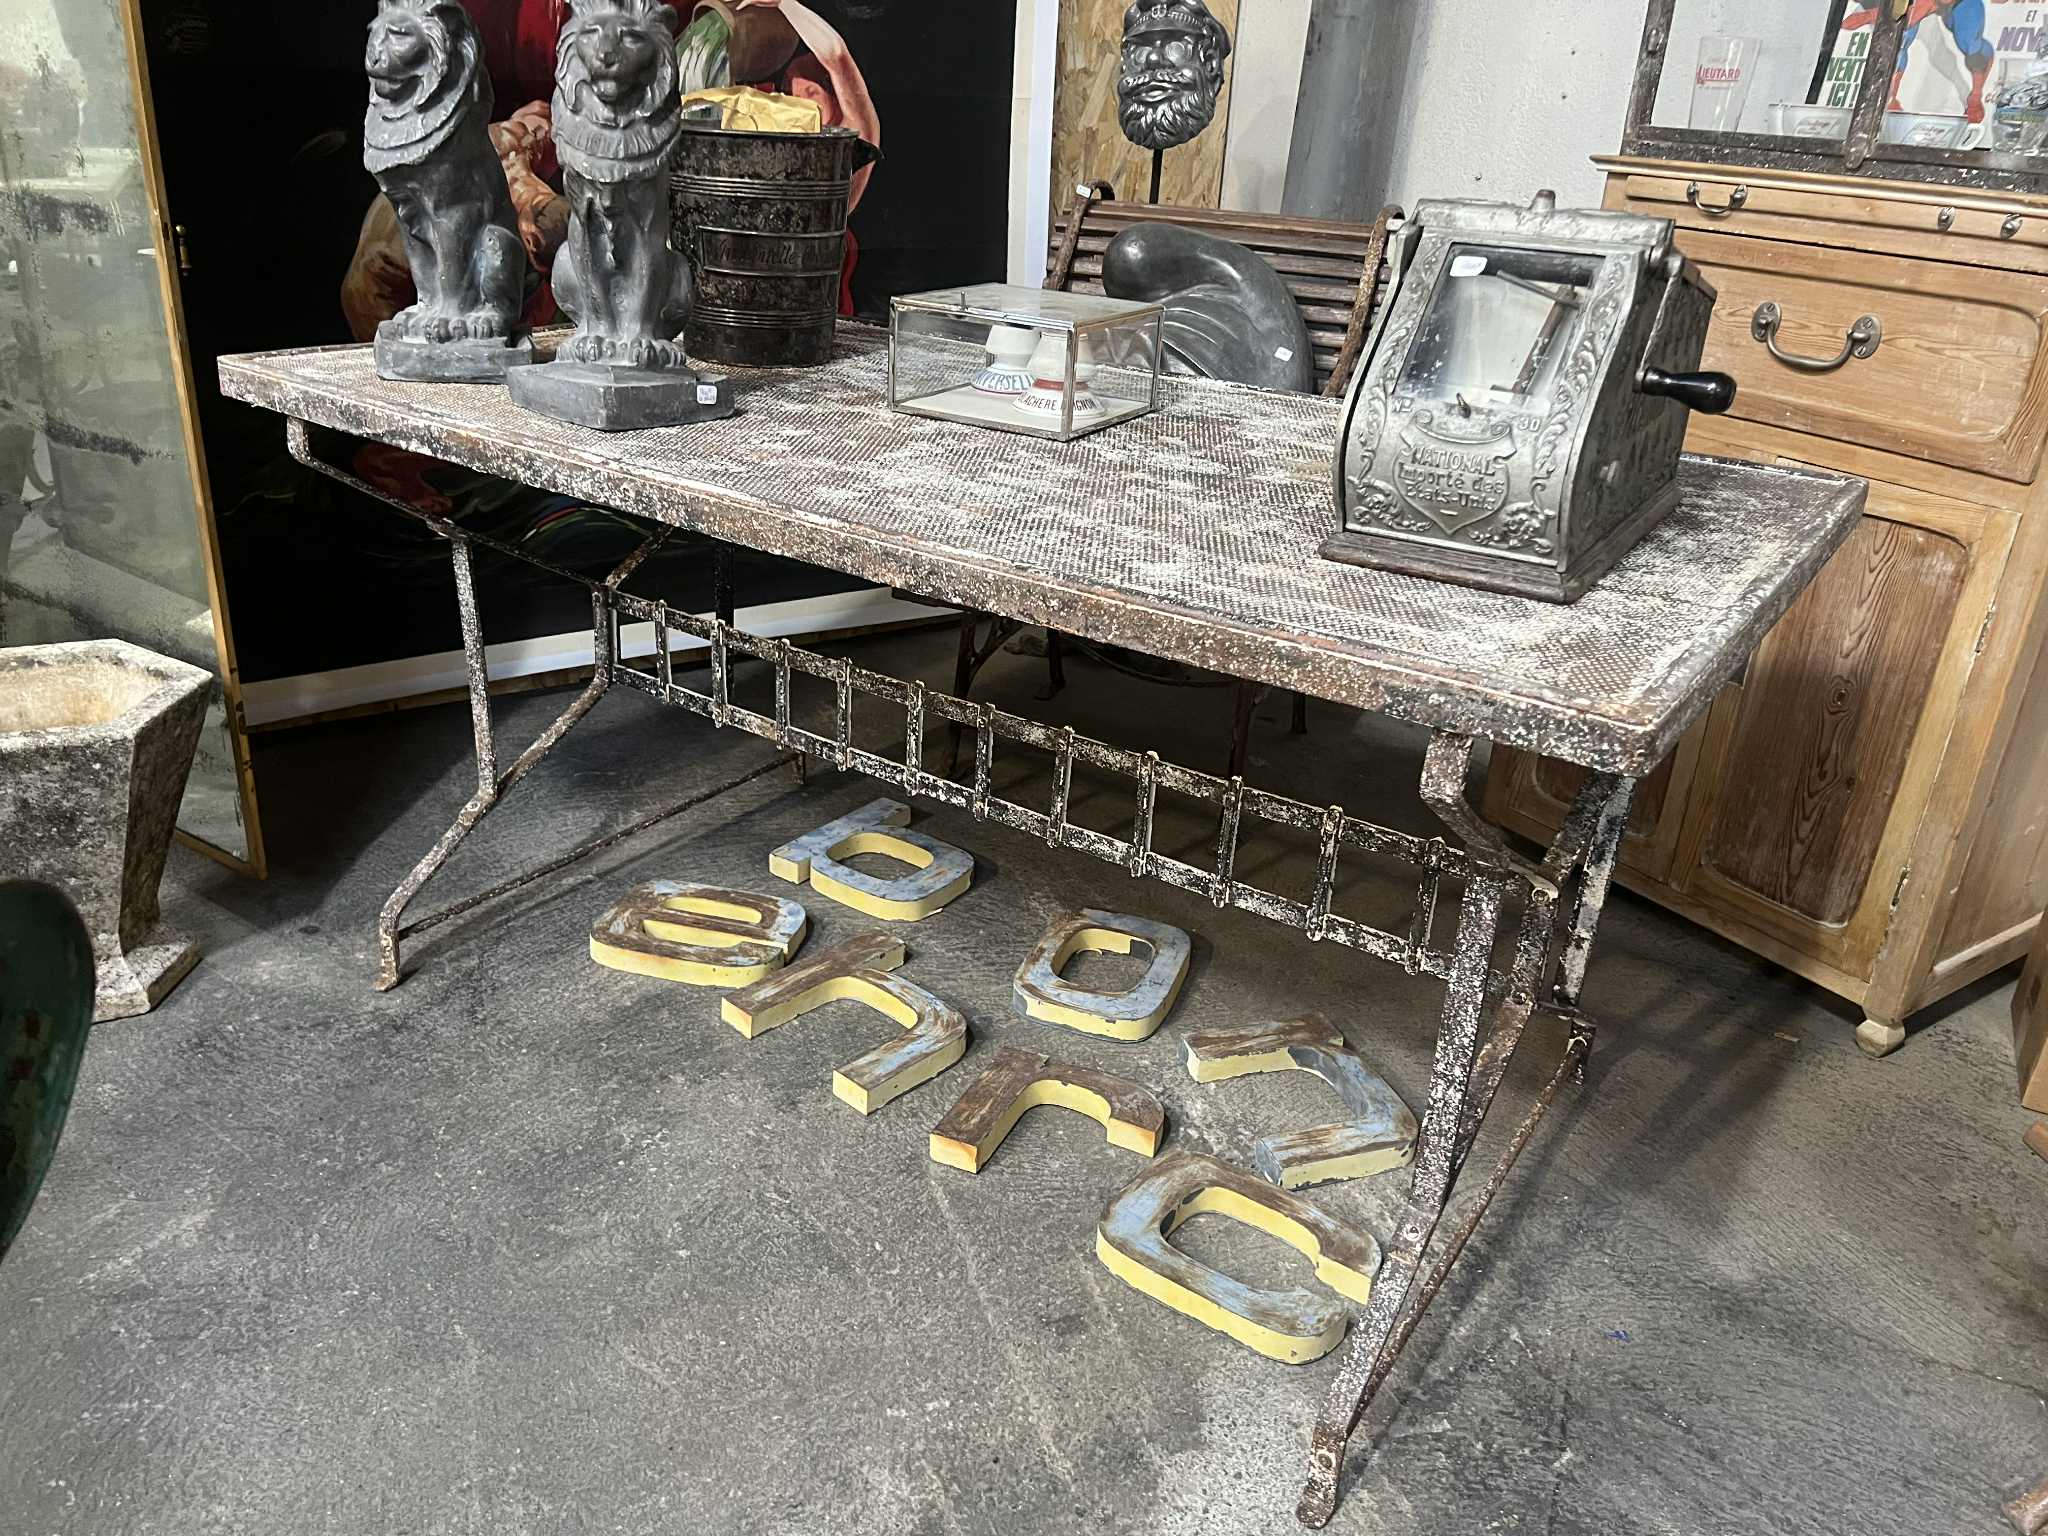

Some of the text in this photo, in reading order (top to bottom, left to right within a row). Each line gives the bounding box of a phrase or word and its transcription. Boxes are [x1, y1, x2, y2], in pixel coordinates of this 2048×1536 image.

[1846, 32, 1870, 57] EN
[1826, 57, 1866, 82] VENT
[1411, 446, 1497, 477] NATIONAL
[1472, 475, 1505, 495] des
